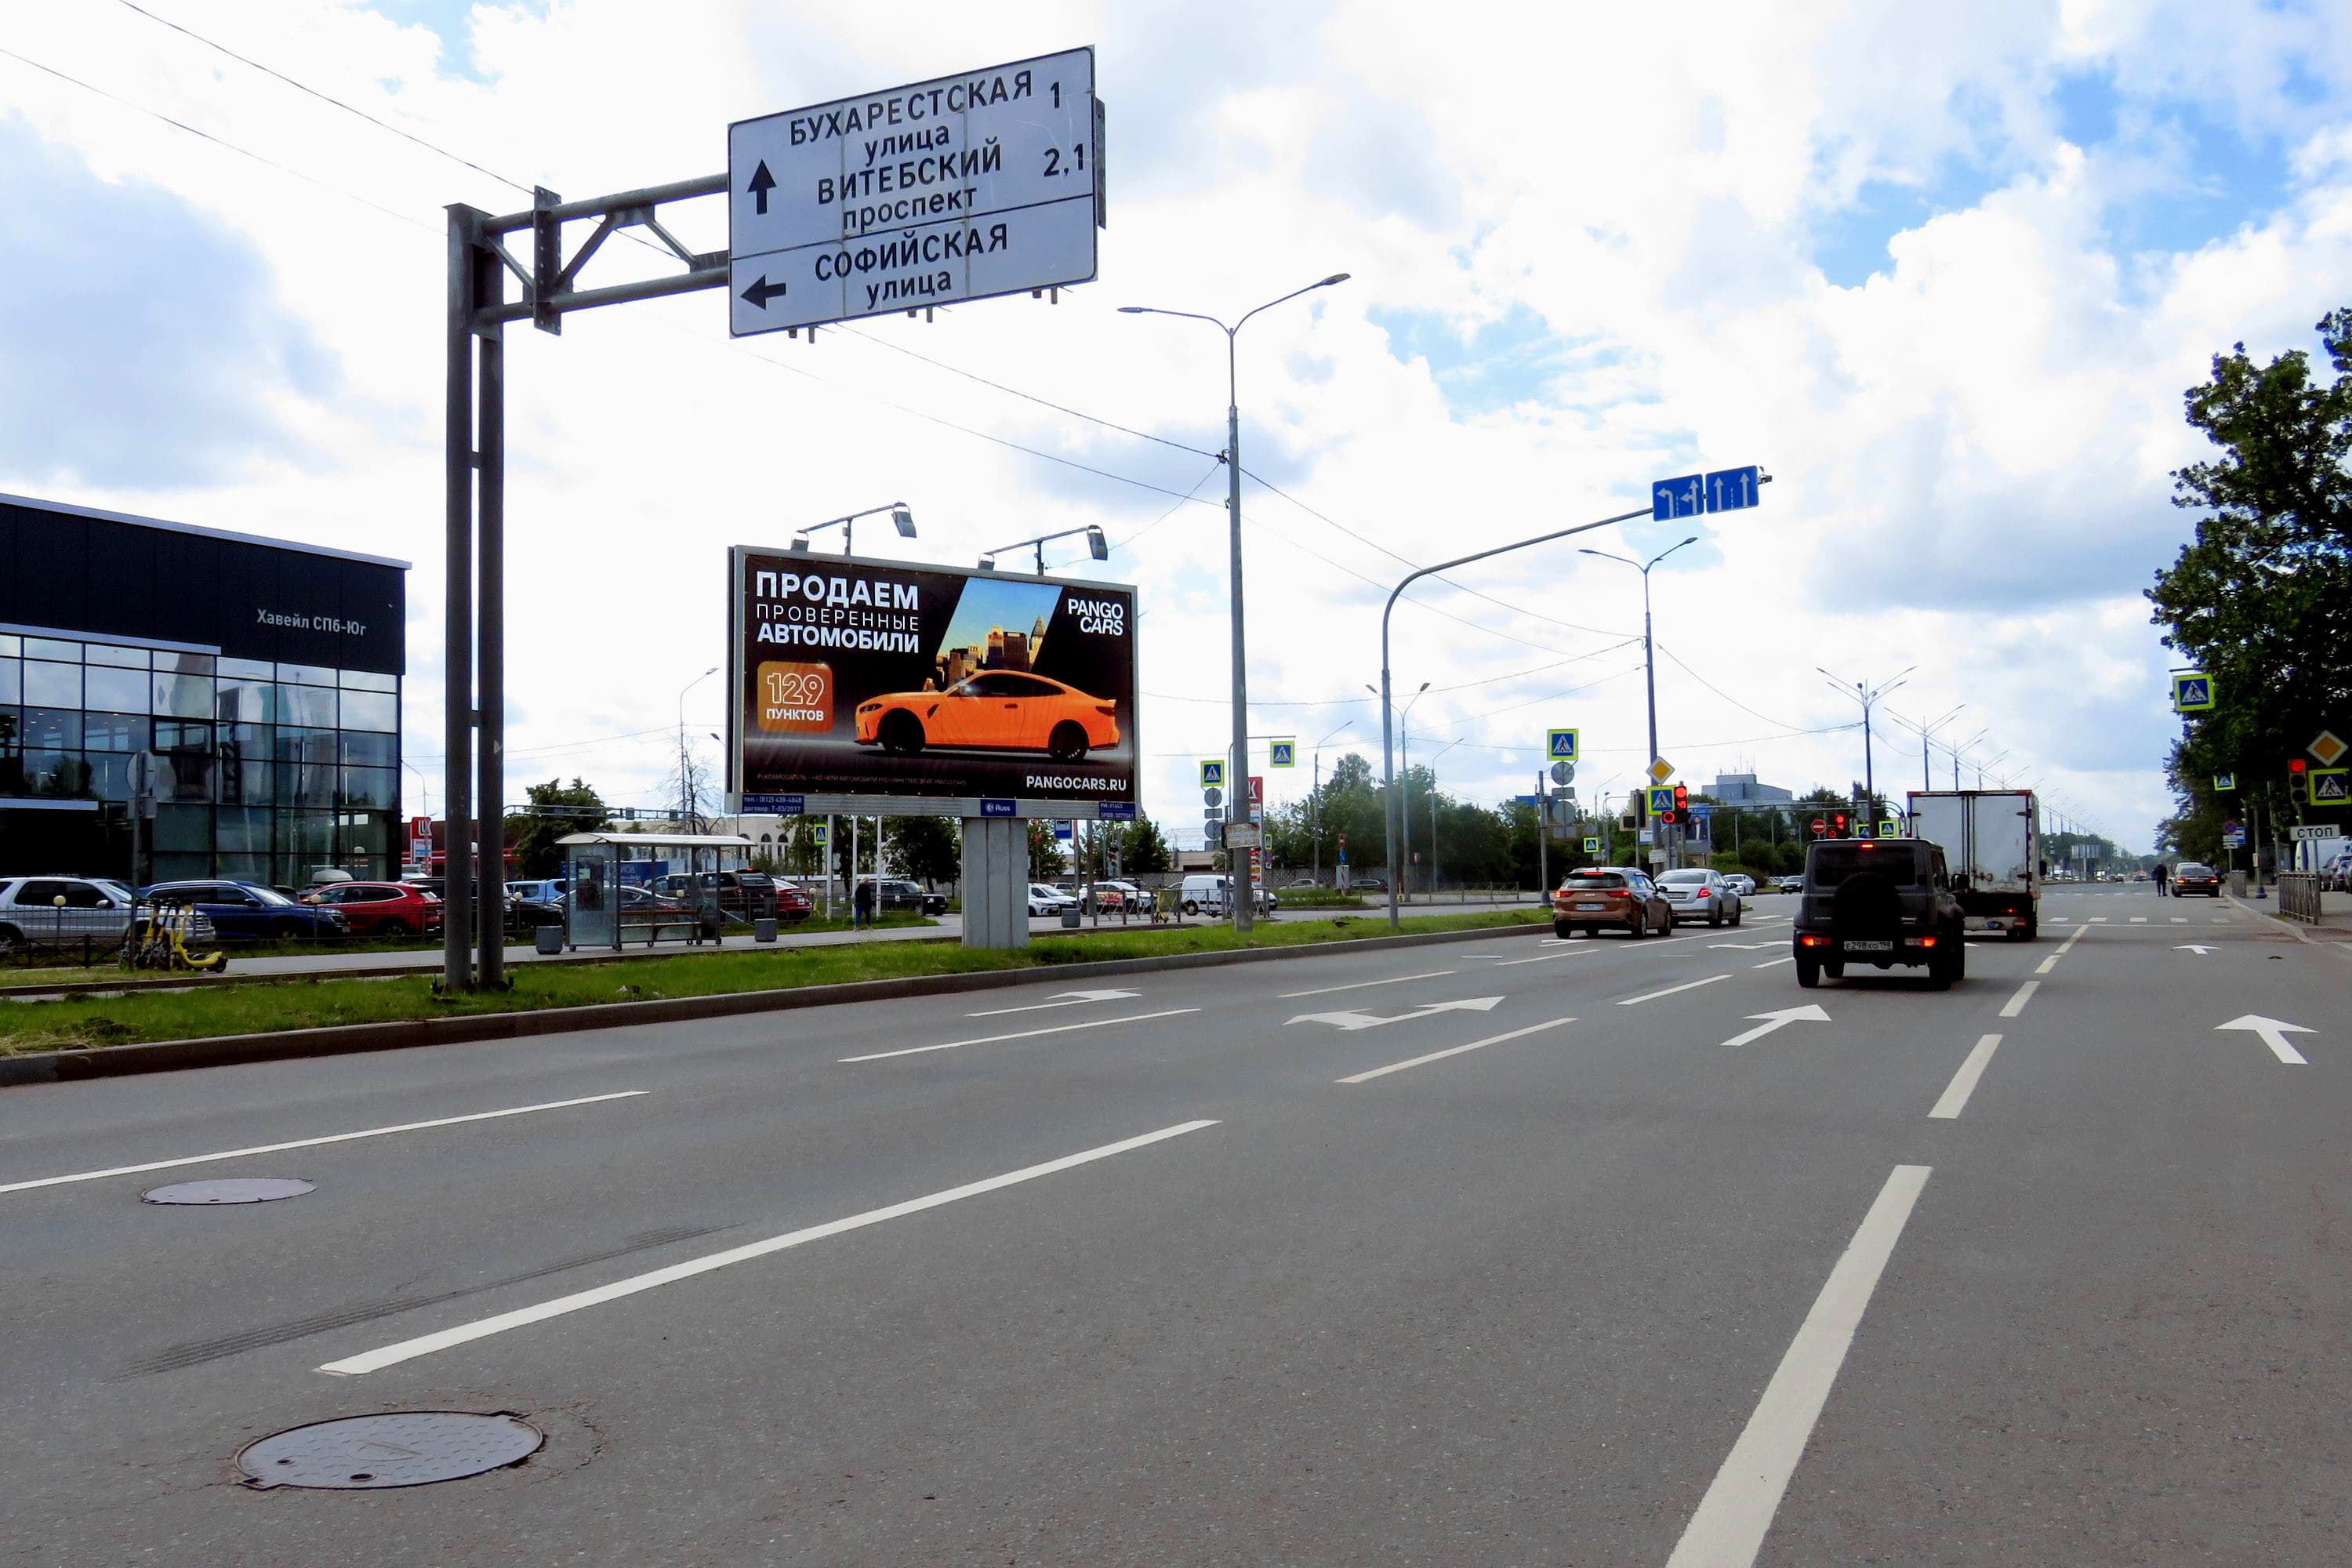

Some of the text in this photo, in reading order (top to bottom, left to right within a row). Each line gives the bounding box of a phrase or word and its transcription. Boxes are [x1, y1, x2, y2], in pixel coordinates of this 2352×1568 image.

[789, 69, 1061, 147] БУХАРЕСТСКАЯ 1
[865, 125, 949, 167] улица
[818, 136, 1085, 205] ВИТЕБСКИЙ 2,1
[844, 186, 978, 237] проспект
[815, 223, 1008, 283] СОФИЙСКАЯ
[866, 270, 952, 310] улица
[757, 571, 919, 611] ПРОДАЕМ
[256, 608, 367, 636] Хавейл СПб-Юг
[757, 604, 919, 631] ПРОВЕРЕННЫЕ
[1068, 598, 1123, 619] PANGO
[757, 622, 919, 653] АВТОМОБИЛИ
[1080, 616, 1123, 636] CARS
[767, 673, 824, 706] 129
[766, 708, 824, 721] ПУНКТОВ
[1026, 775, 1127, 791] PANGOCARS.RU
[2297, 827, 2333, 838] СТОП
